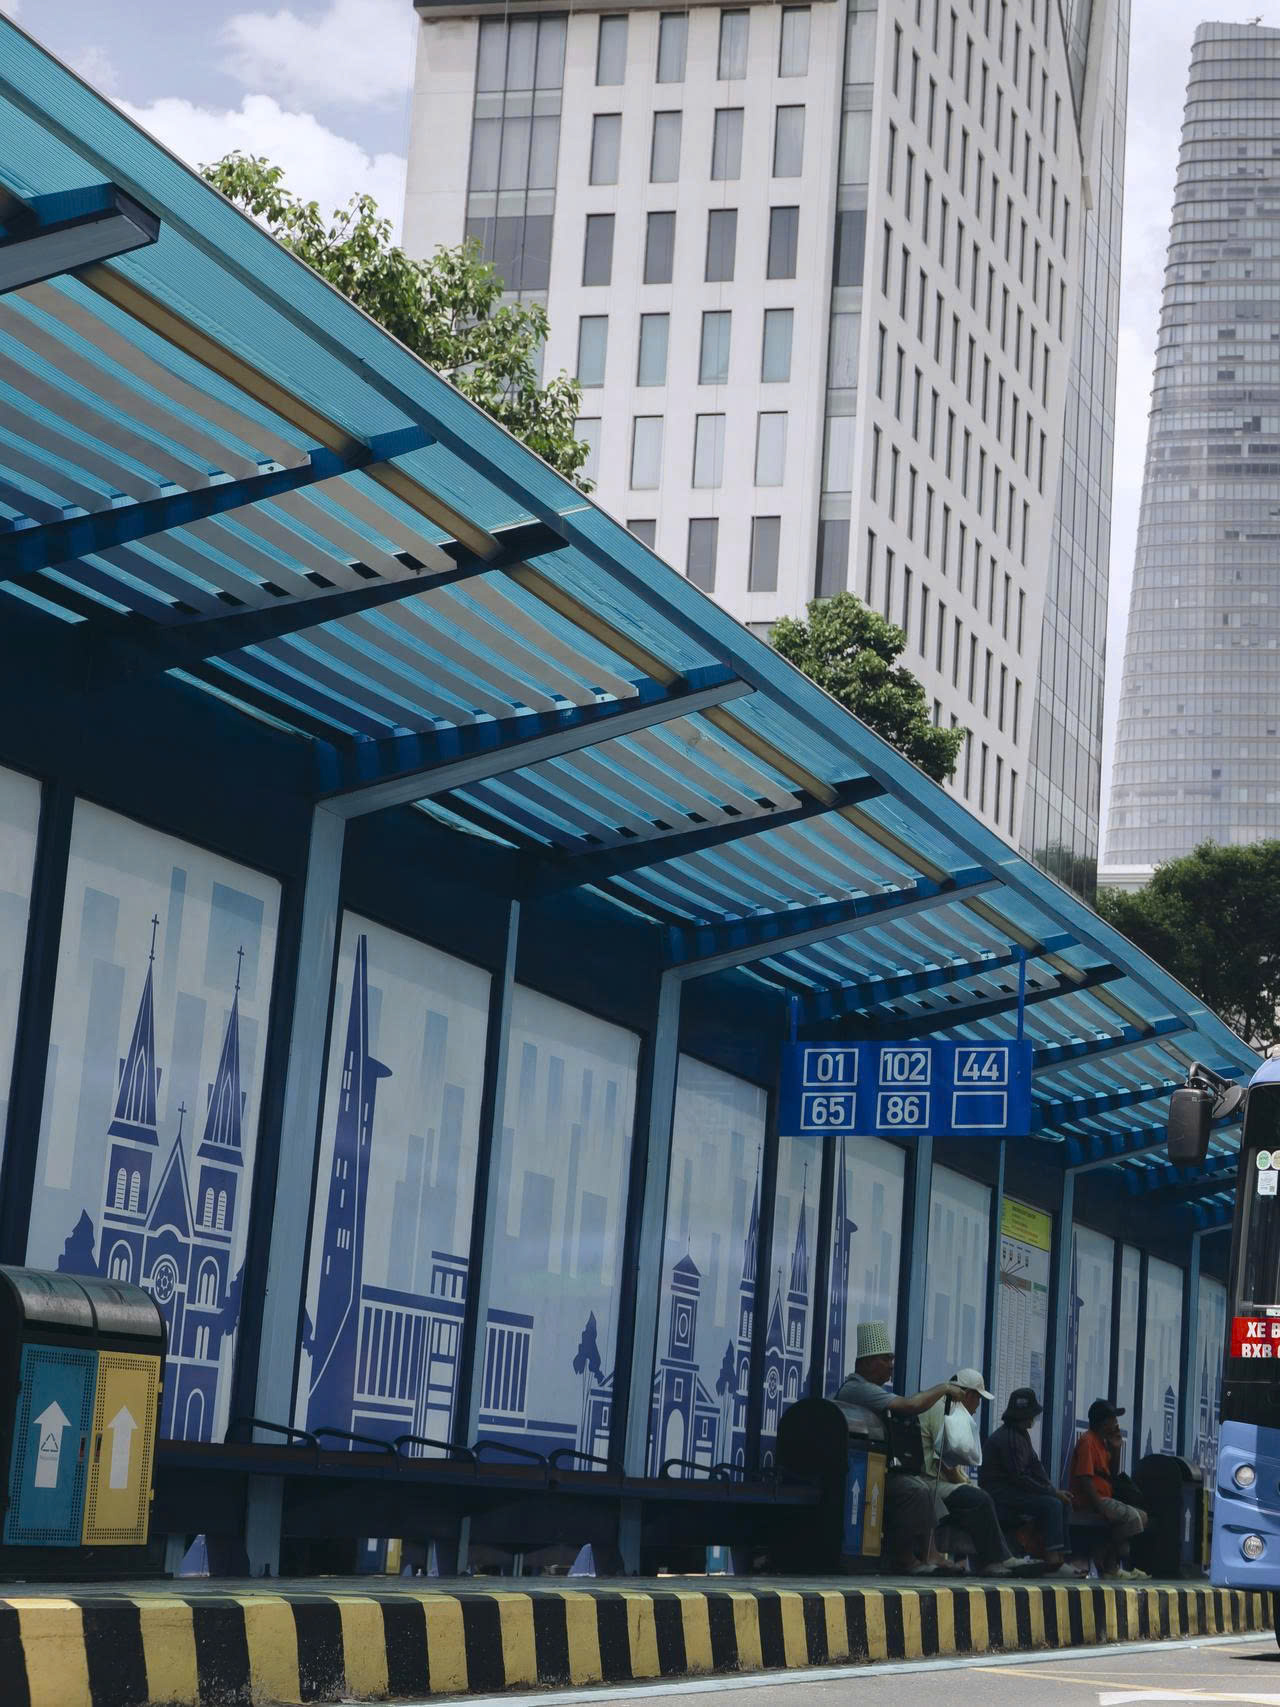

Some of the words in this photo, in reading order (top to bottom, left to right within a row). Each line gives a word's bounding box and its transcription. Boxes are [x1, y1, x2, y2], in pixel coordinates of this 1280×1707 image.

[817, 1053, 844, 1081] 01
[883, 1053, 926, 1081] 102
[962, 1052, 999, 1081] 44
[812, 1097, 845, 1125] 65
[886, 1096, 920, 1124] 86
[1246, 1321, 1266, 1338] XE
